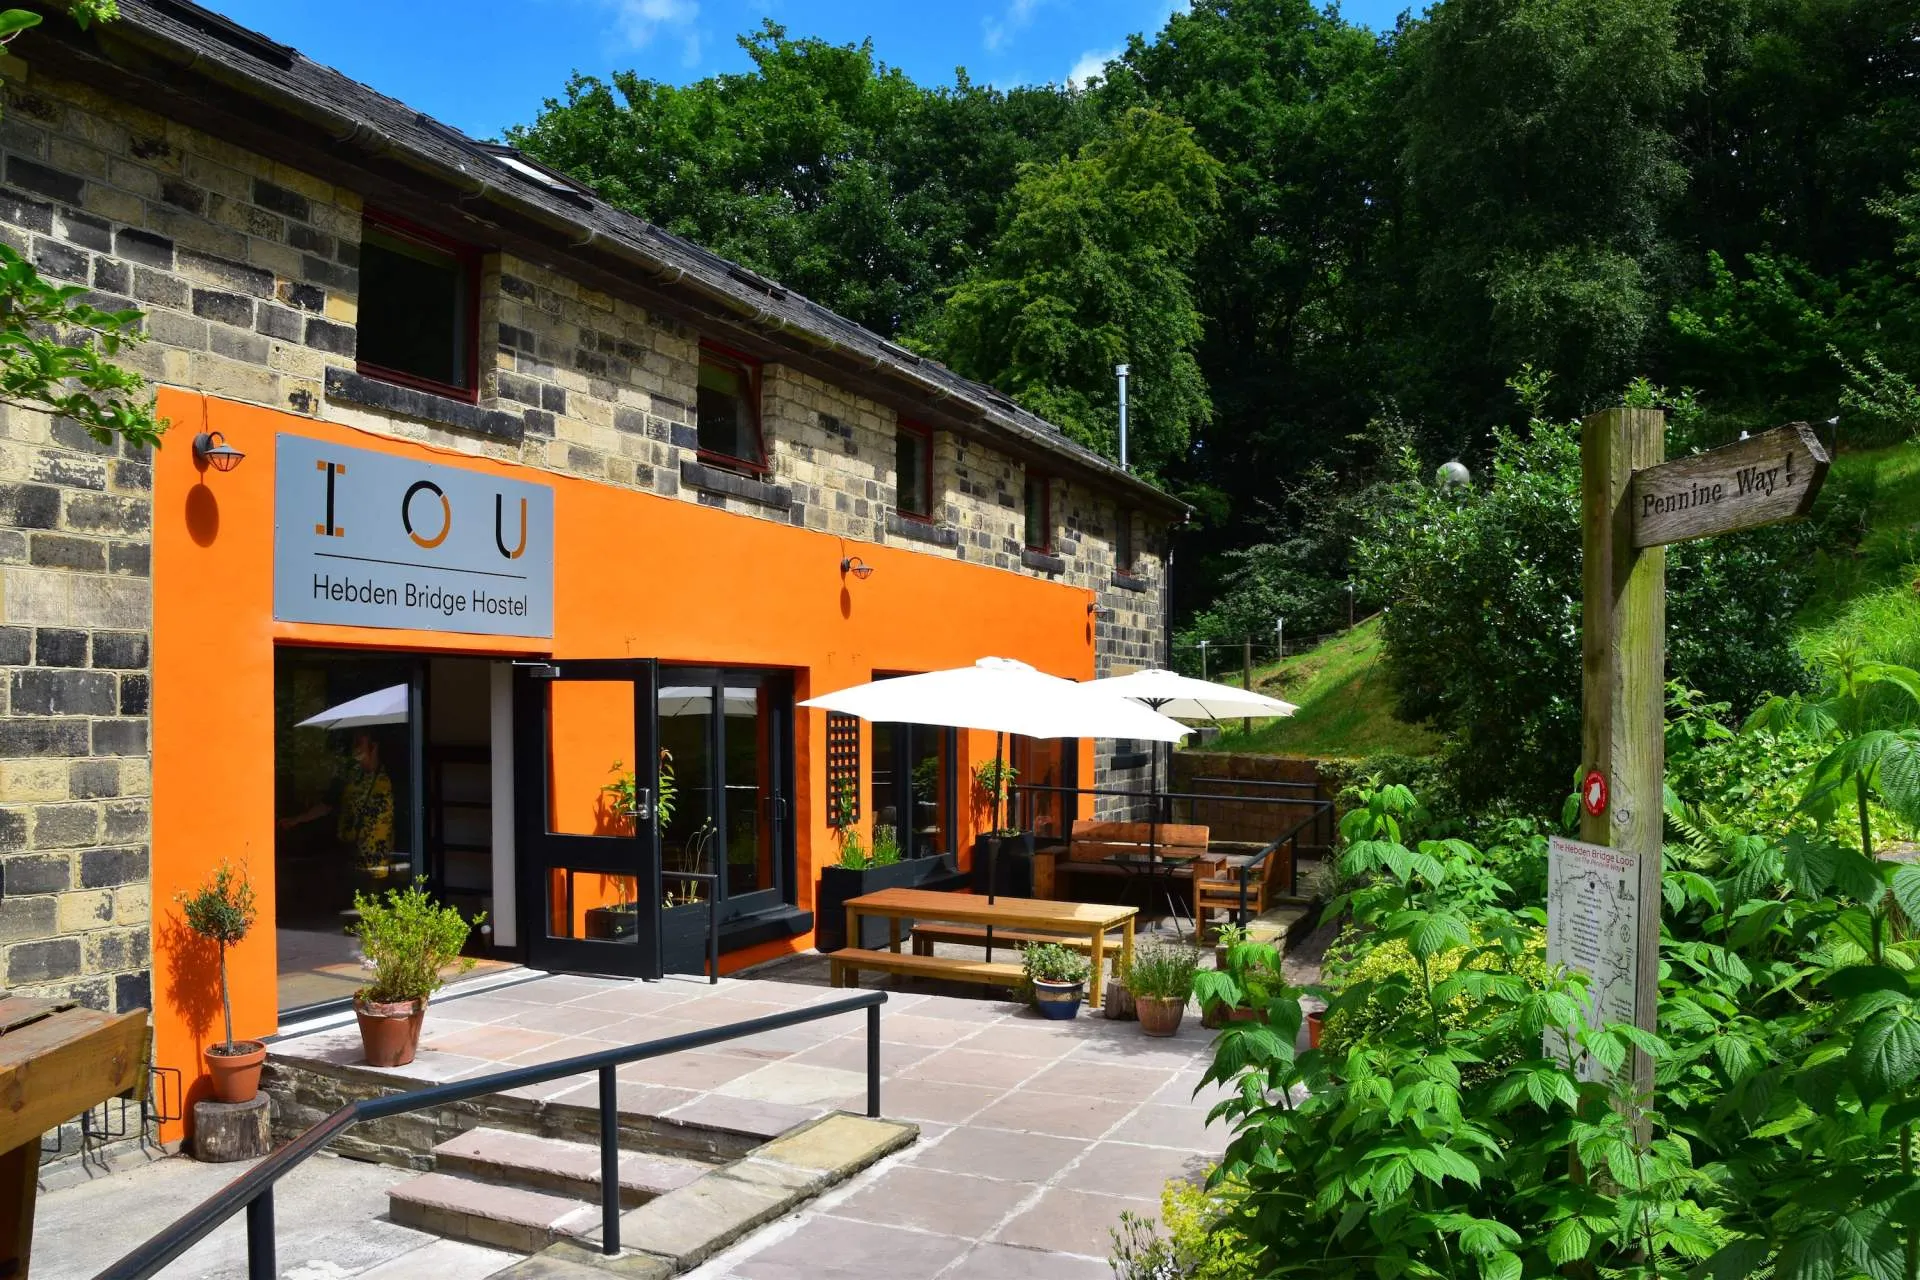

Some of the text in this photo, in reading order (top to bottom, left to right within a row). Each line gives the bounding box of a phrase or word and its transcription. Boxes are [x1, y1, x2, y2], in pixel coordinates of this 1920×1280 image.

[1642, 482, 1722, 518] Pennine
[313, 573, 528, 617] Hebden Bridge Hostel
[1553, 840, 1564, 851] The
[1565, 844, 1591, 857] Hebden
[1592, 849, 1615, 863] Bridge
[1616, 855, 1635, 867] Loop
